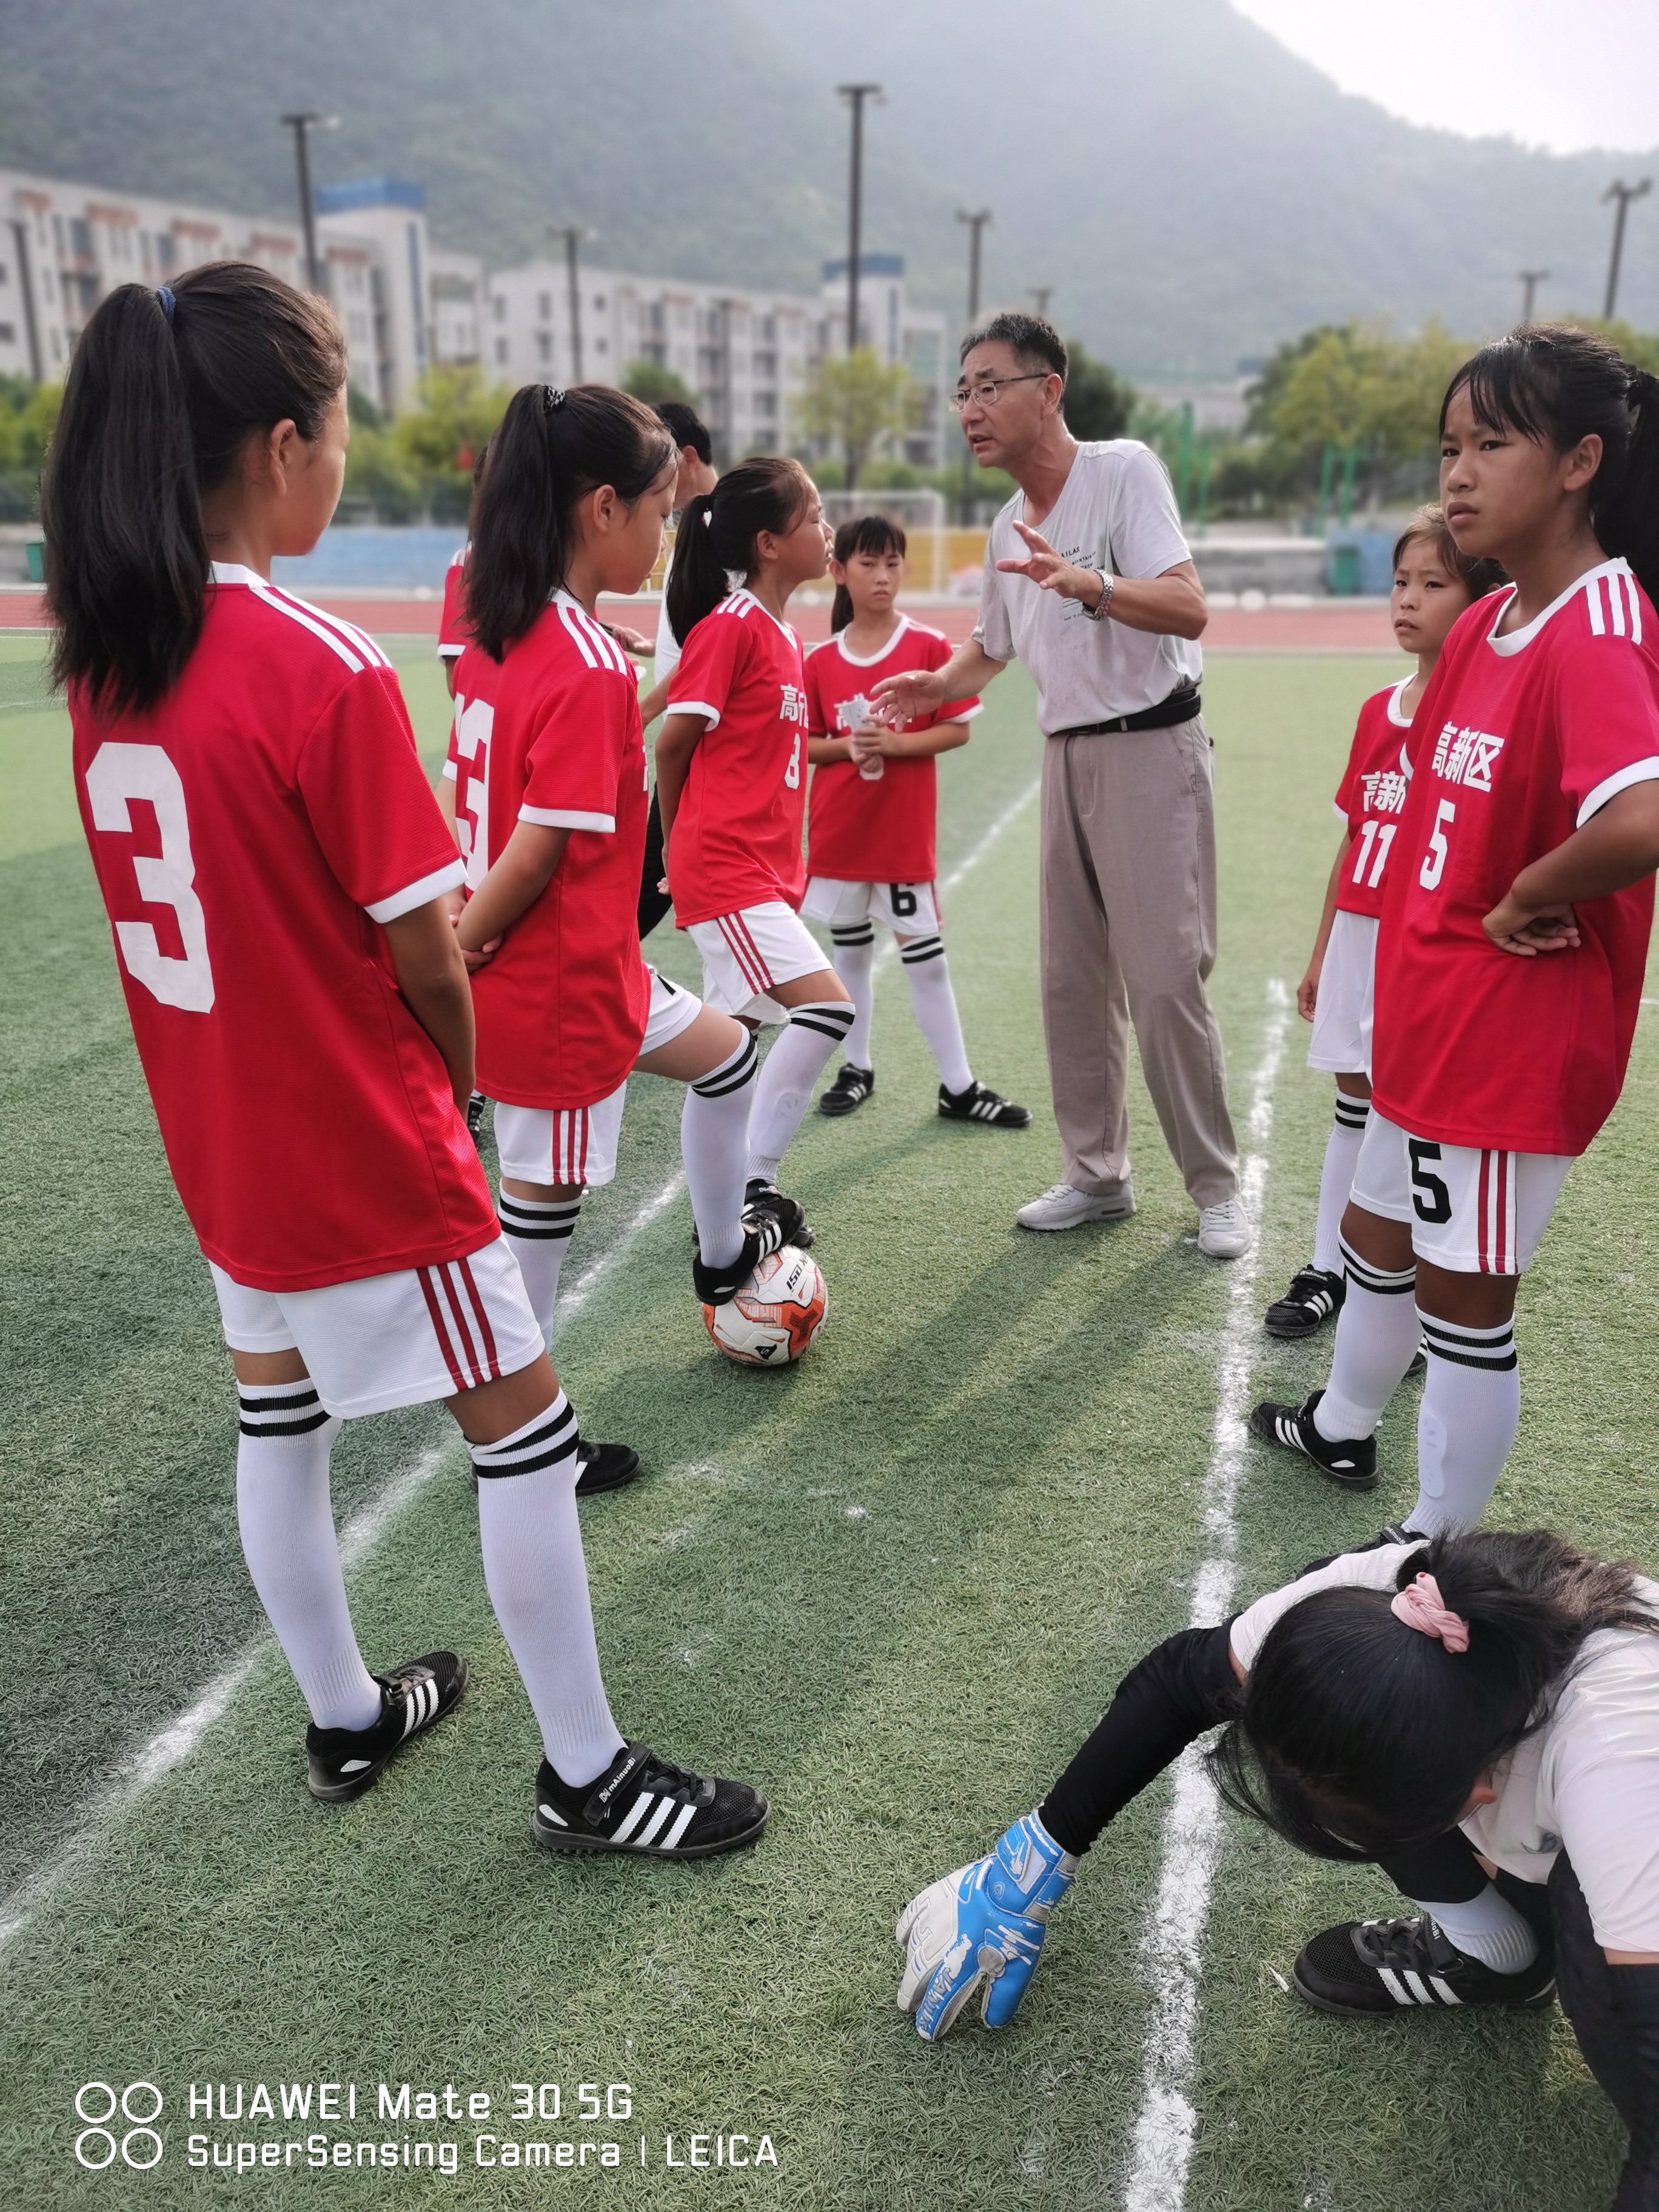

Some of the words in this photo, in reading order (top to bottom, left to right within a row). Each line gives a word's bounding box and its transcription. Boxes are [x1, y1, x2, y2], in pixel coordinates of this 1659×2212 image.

[1061, 546, 1080, 558] AILAS
[1431, 720, 1505, 793] 高新区
[1361, 771, 1406, 814] 高新
[85, 741, 215, 1014] 3
[1352, 819, 1398, 889] 11
[1419, 797, 1456, 891] 5
[889, 882, 918, 917] 6
[1408, 1138, 1453, 1225] 5
